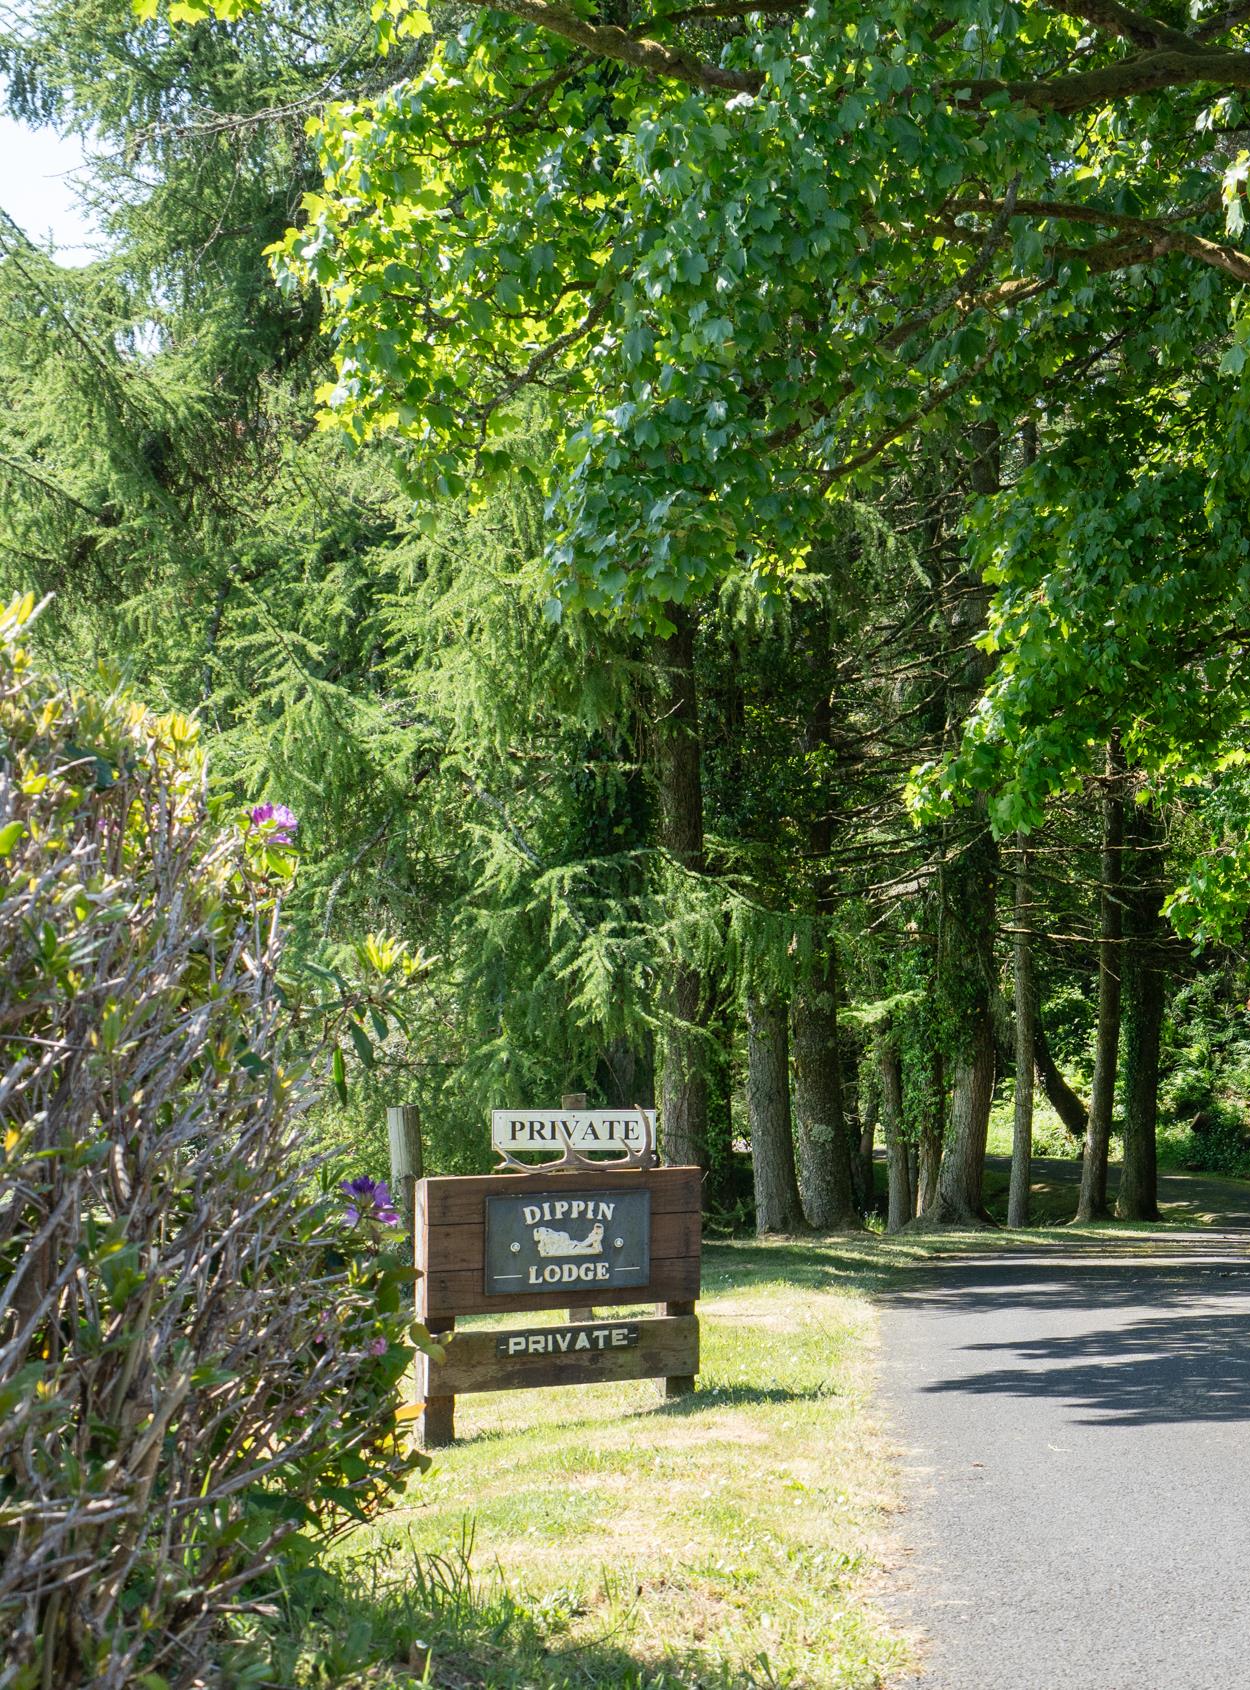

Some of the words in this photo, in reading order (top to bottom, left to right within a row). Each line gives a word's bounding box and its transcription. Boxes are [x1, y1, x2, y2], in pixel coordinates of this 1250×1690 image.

[509, 1120, 640, 1141] PRIVATE
[523, 1200, 616, 1225] DIPPIN
[529, 1262, 610, 1283] LODGE
